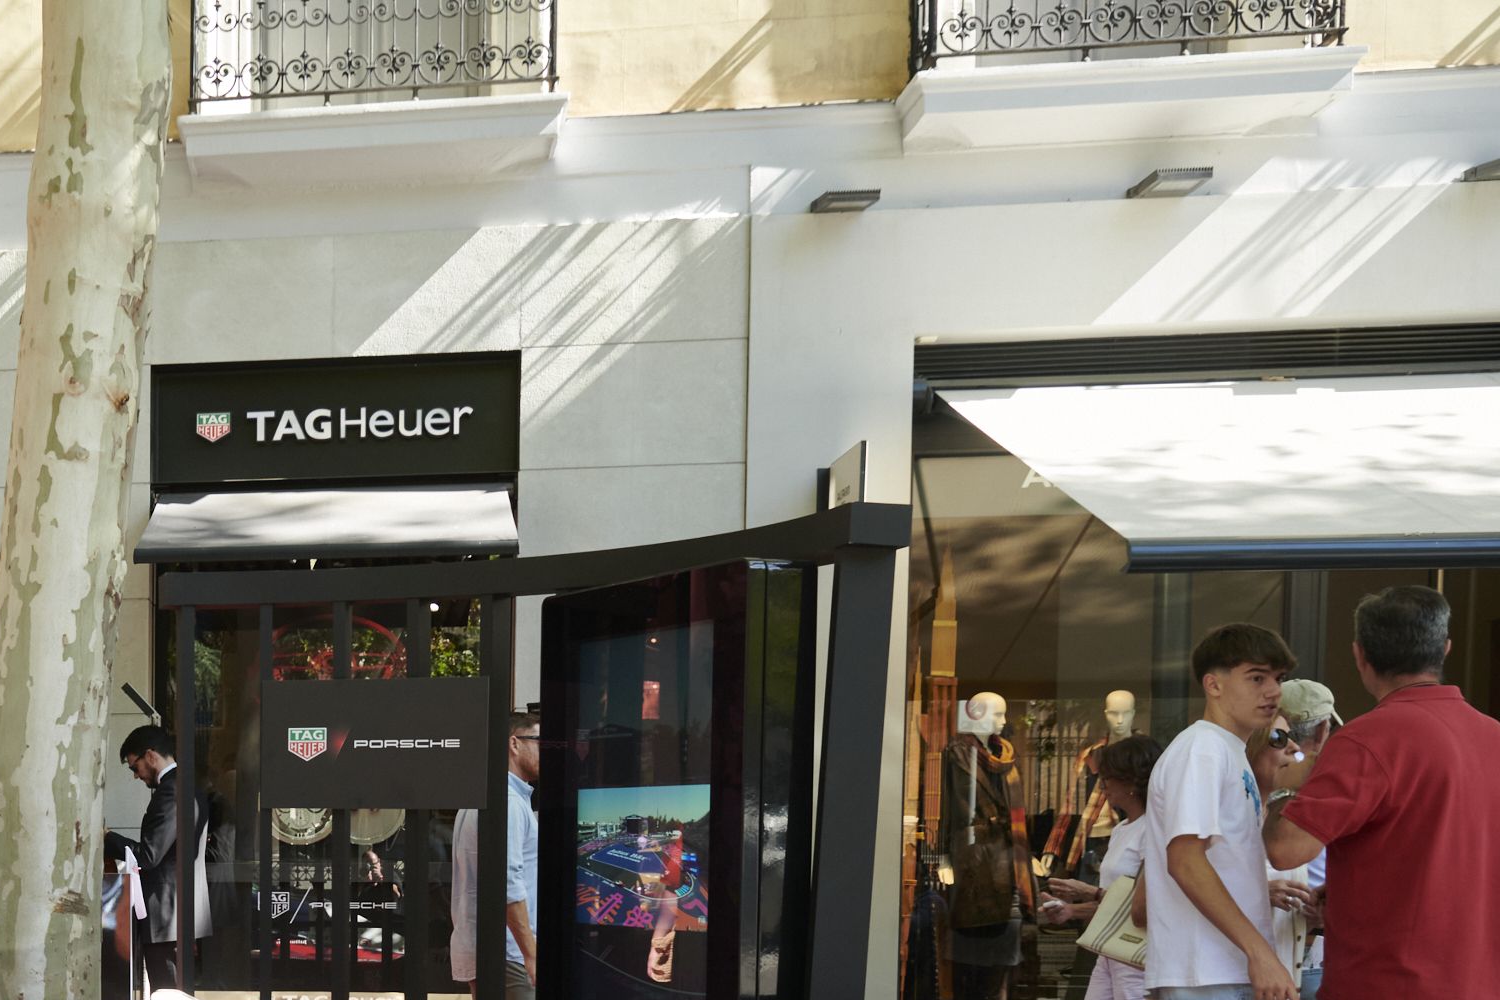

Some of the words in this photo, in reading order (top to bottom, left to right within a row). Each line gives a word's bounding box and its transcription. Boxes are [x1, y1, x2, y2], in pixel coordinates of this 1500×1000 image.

[200, 414, 228, 424] TAG
[198, 425, 229, 440] HEUER
[291, 730, 324, 740] TAG
[353, 739, 461, 749] PORSCHE
[290, 742, 324, 757] HEUER
[311, 901, 397, 910] POSCHE
